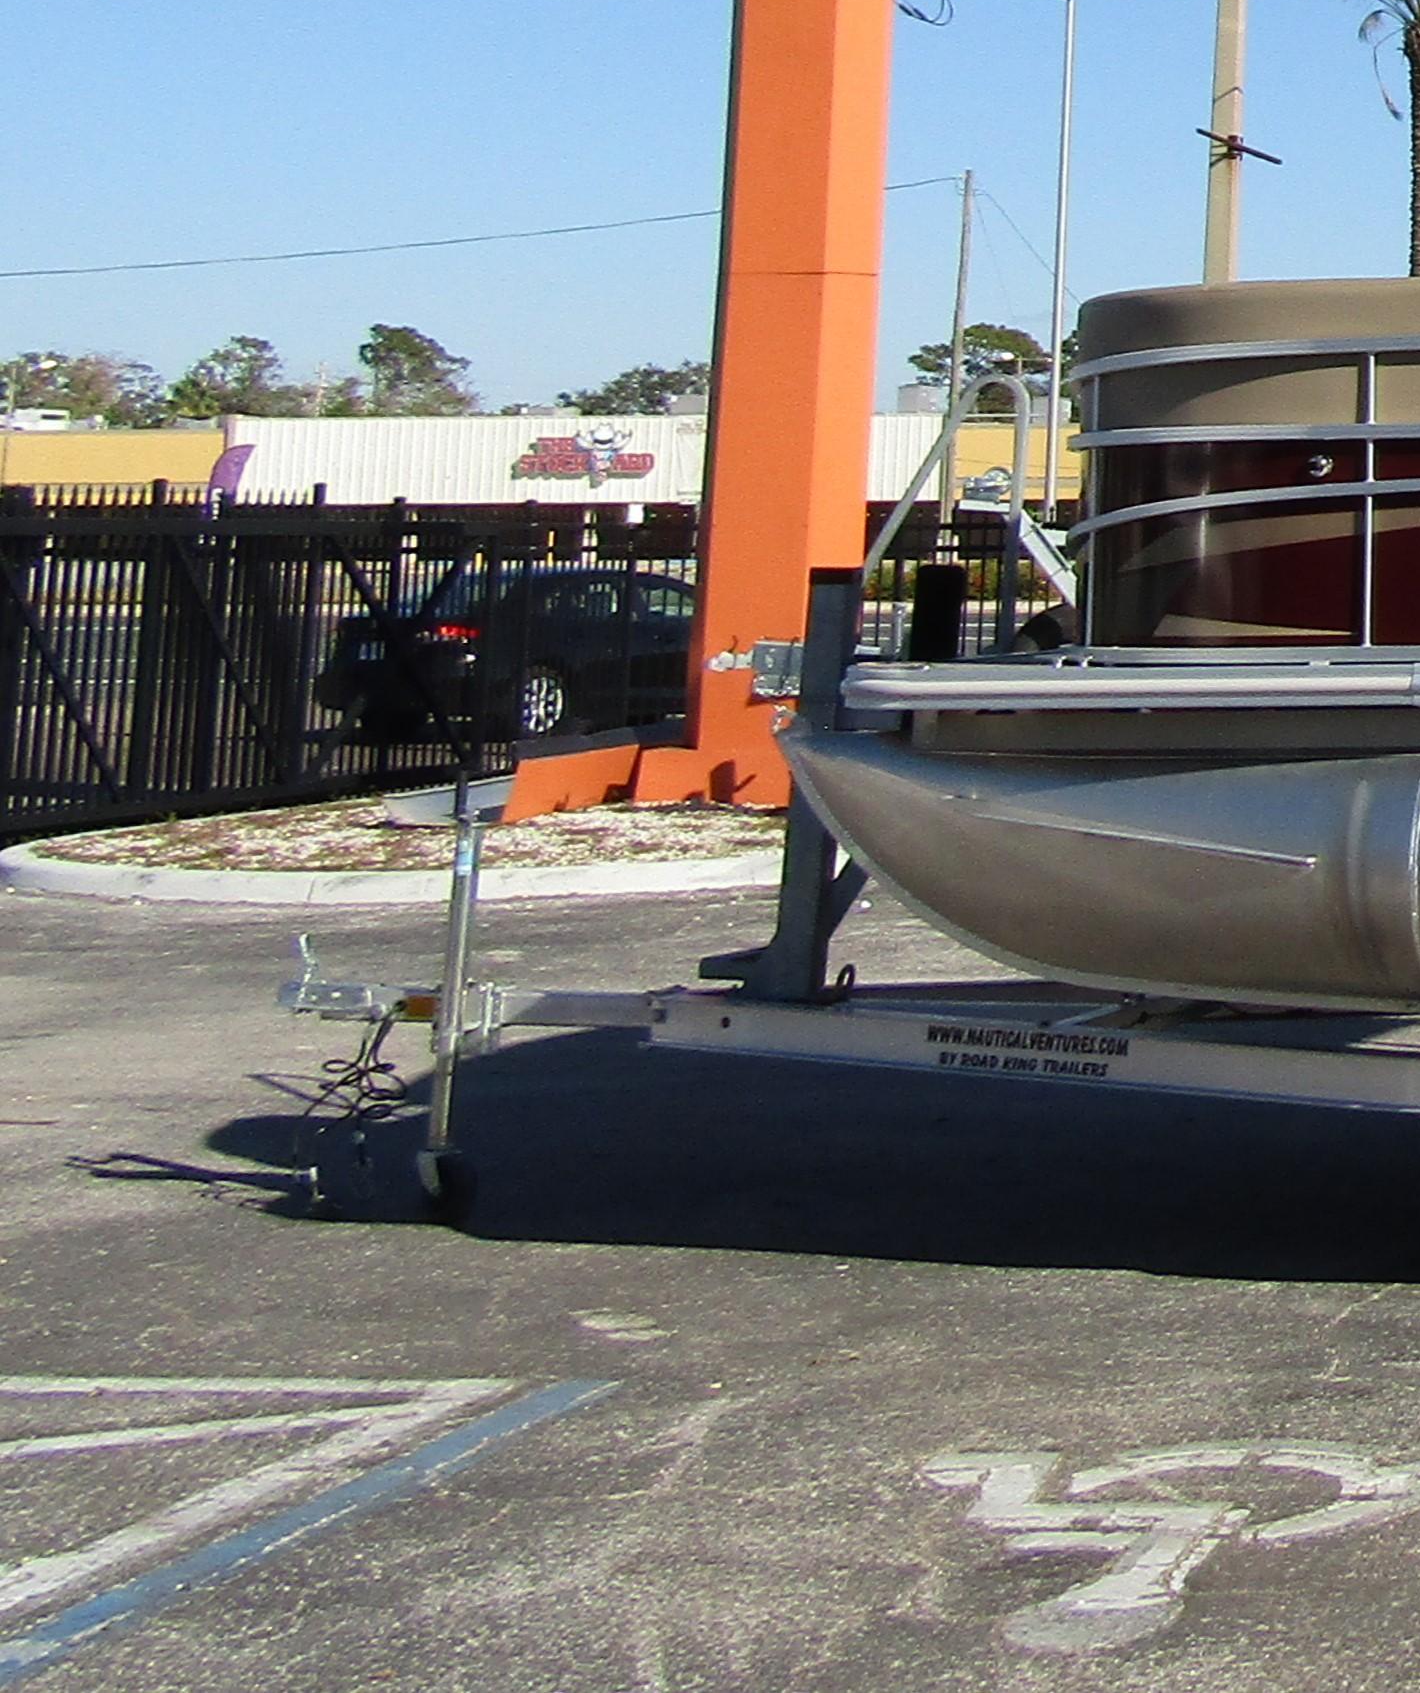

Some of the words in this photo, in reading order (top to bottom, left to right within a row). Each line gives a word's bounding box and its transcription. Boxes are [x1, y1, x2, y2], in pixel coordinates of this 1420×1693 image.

[927, 1024, 1130, 1056] WWW.NAUTICALVENTURES.COM
[960, 1053, 999, 1069] ROAD
[1002, 1056, 1037, 1072] KING
[1040, 1058, 1109, 1078] TRAILERS
